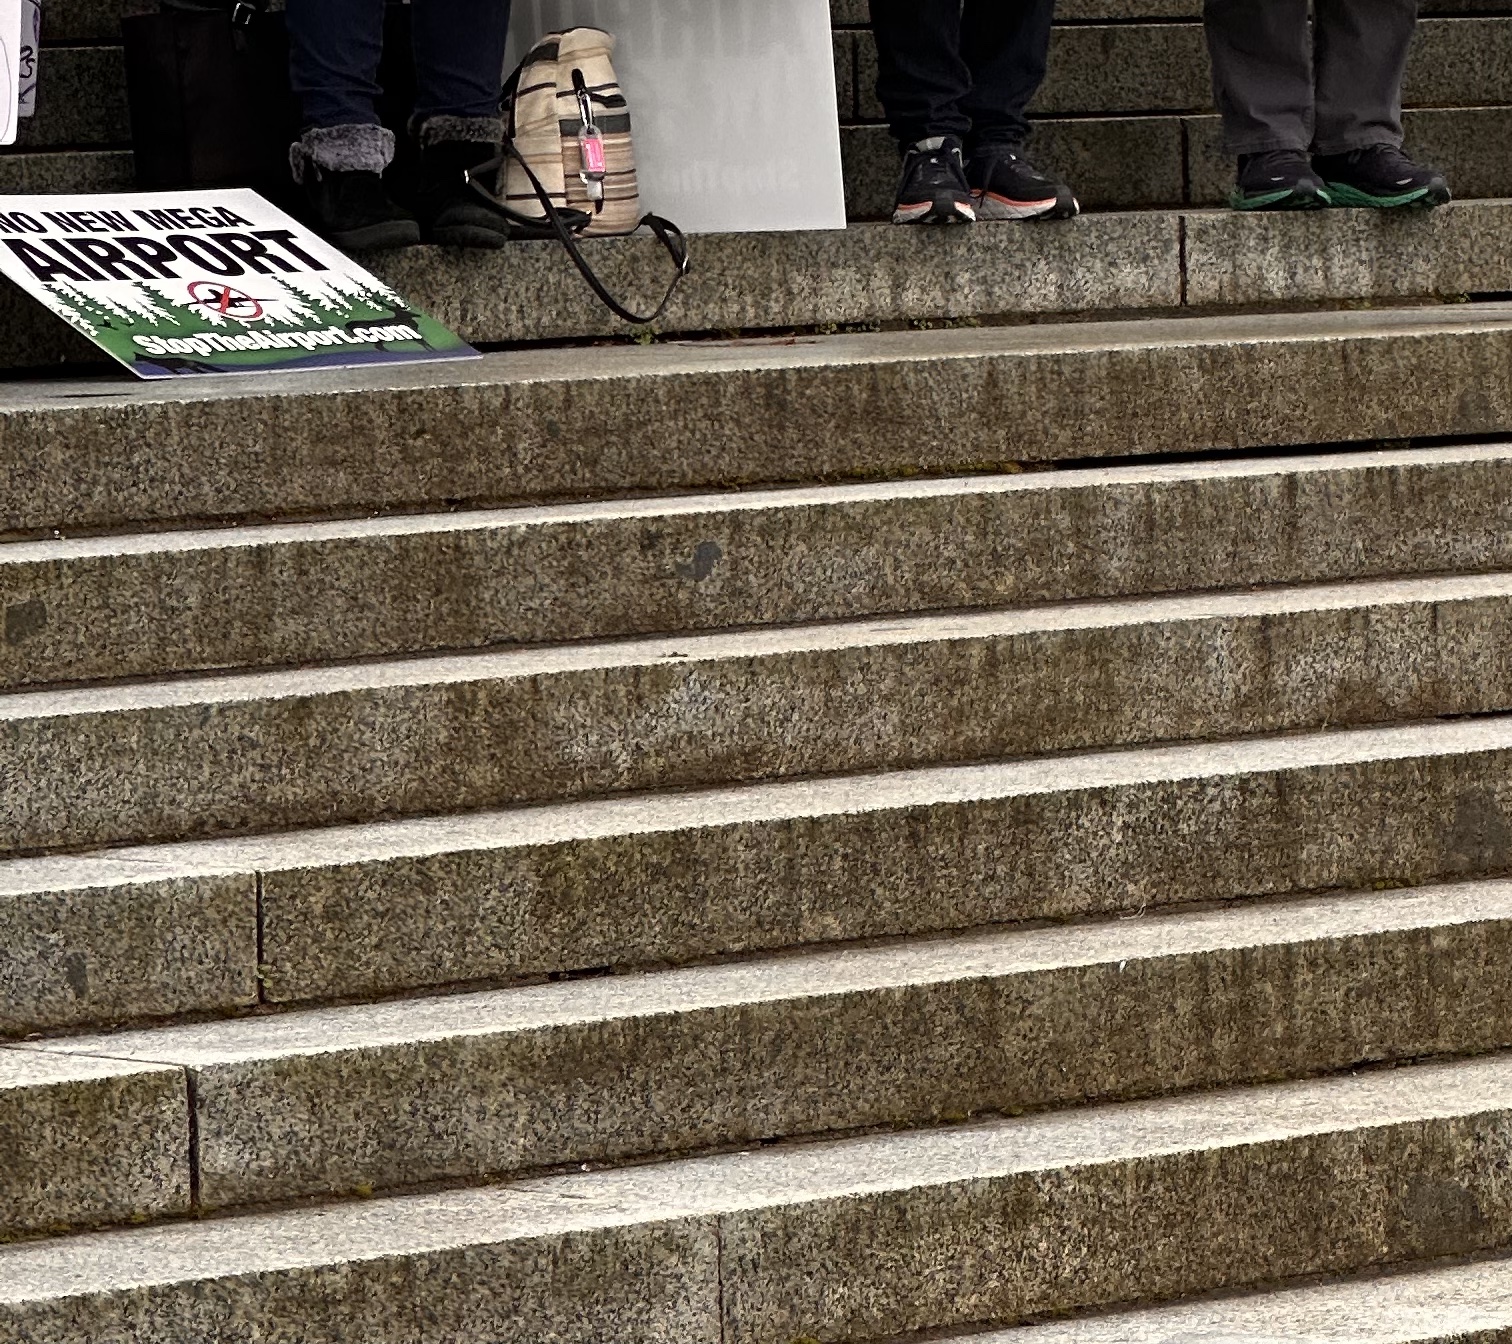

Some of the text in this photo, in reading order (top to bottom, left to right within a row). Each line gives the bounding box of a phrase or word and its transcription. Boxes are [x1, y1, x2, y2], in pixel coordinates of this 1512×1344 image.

[47, 210, 129, 234] NEW
[140, 206, 253, 231] MEGA
[2, 230, 331, 282] AIRPORT
[132, 323, 423, 357] StopTheAirport.com
